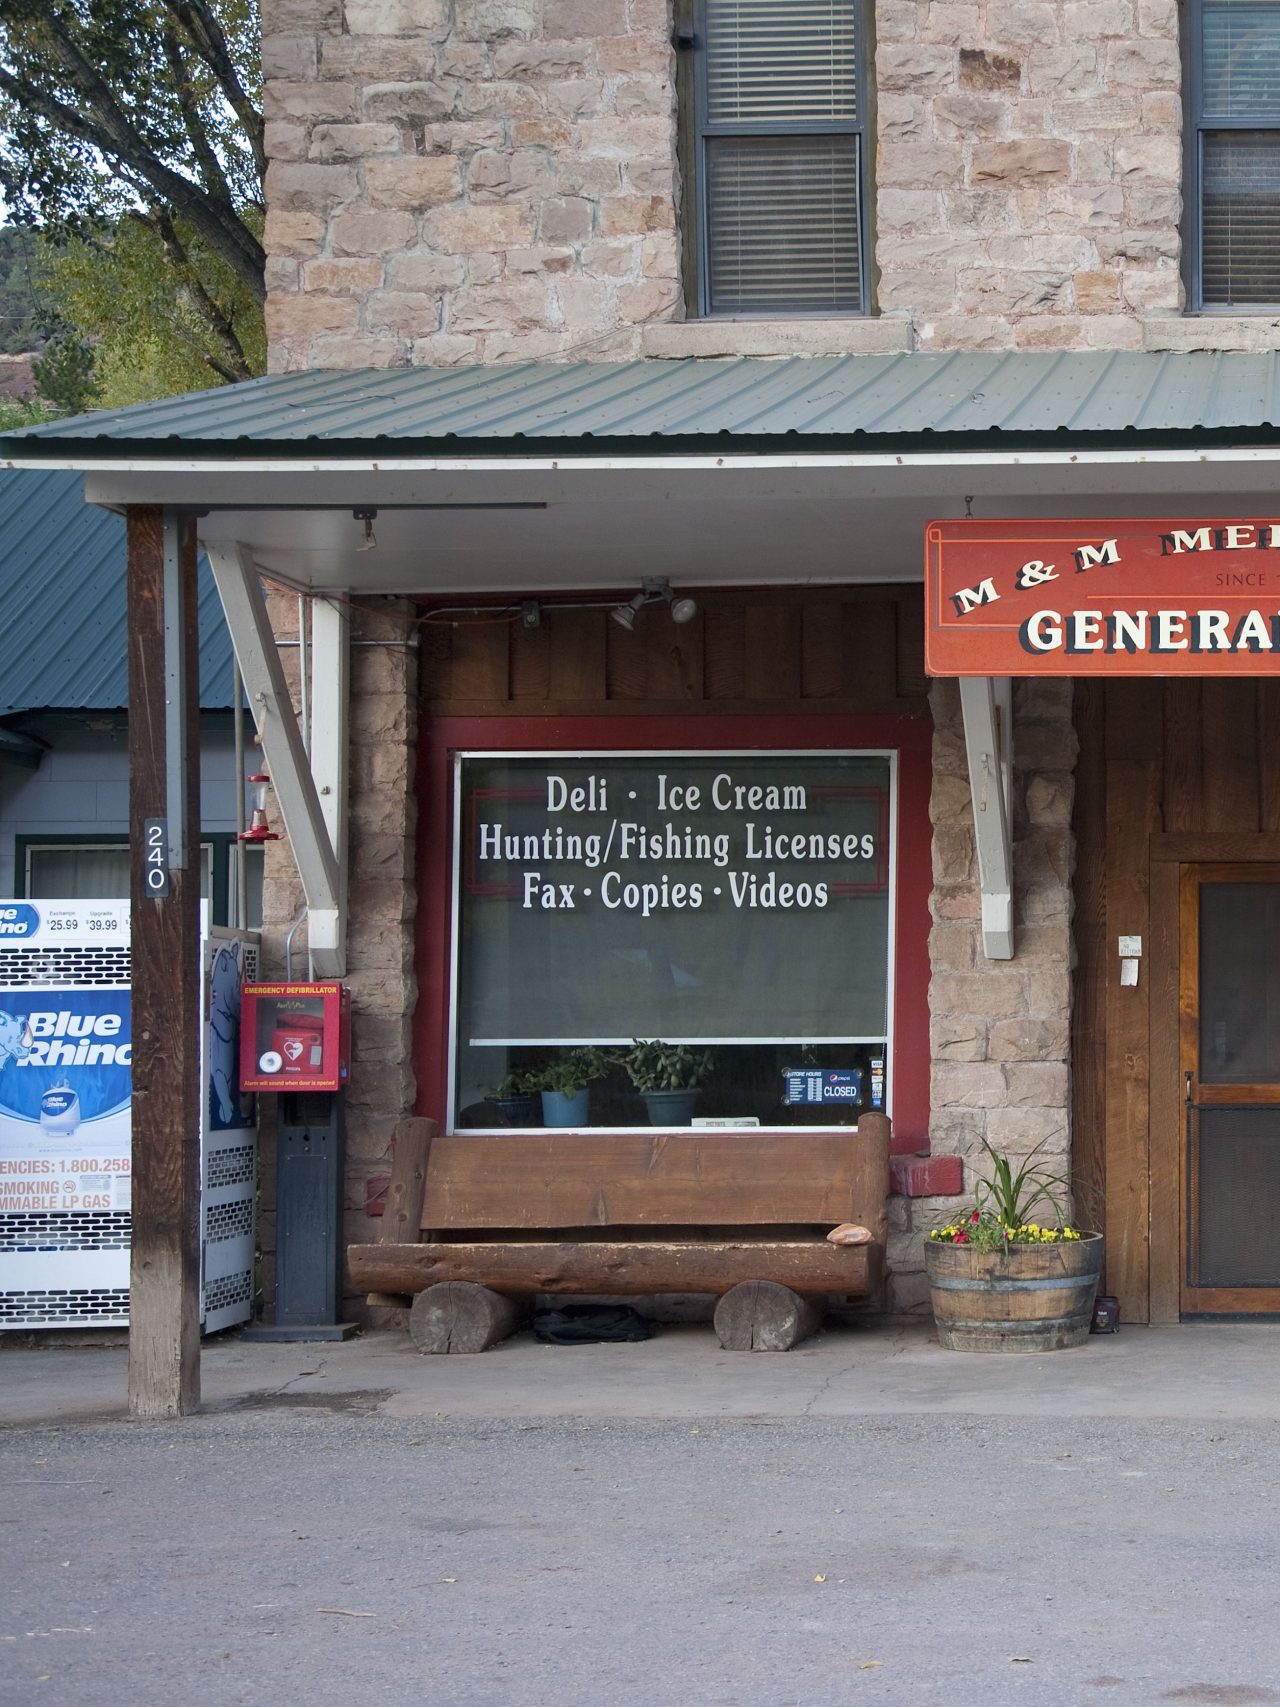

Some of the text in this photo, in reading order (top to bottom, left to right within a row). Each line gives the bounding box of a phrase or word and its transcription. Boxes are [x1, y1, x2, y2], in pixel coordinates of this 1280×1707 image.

[956, 577, 1001, 613] M
[1020, 560, 1060, 588] &
[1076, 538, 1122, 571] M
[1215, 573, 1266, 587] SINCE
[546, 773, 807, 812] Deli Ice Cream
[148, 826, 165, 889] 240
[479, 818, 875, 868] Hunting/Fishing Licenses
[522, 871, 828, 917] Fax Copies Videos
[28, 1011, 121, 1037] Blue
[824, 1086, 857, 1096] CLOSED
[59, 1159, 130, 1173] 1.800.258
[62, 1196, 79, 1209] LP
[82, 1195, 111, 1208] GAS
